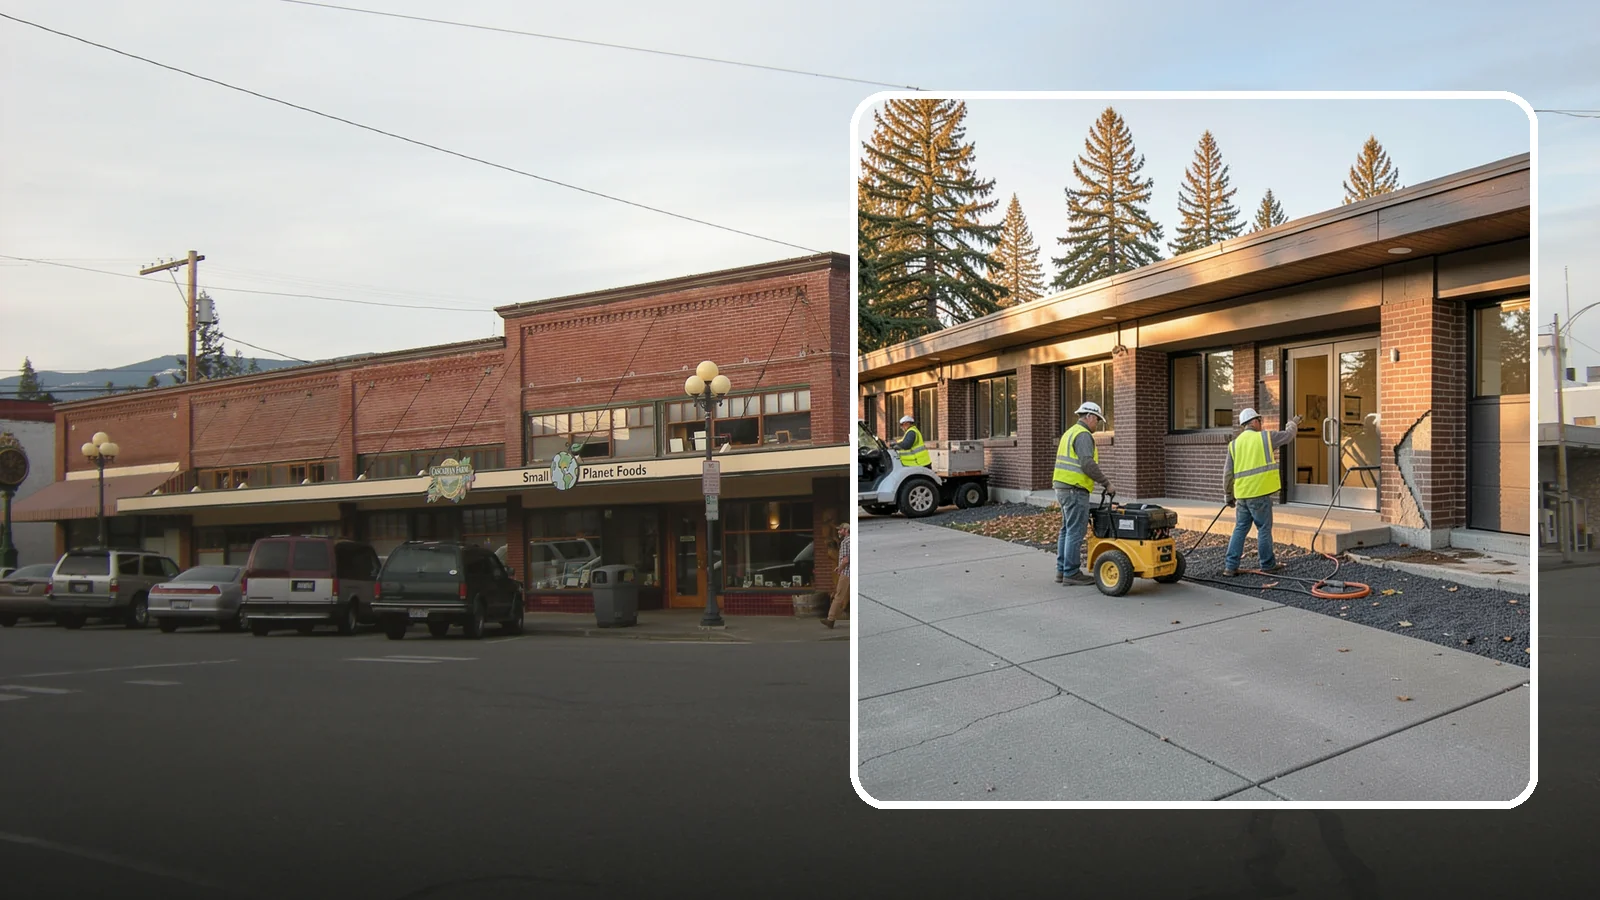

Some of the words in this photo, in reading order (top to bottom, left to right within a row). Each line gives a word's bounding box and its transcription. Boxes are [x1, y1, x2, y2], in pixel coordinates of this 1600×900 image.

[523, 471, 549, 483] Small
[583, 467, 614, 479] Planet
[617, 464, 647, 477] Foods
